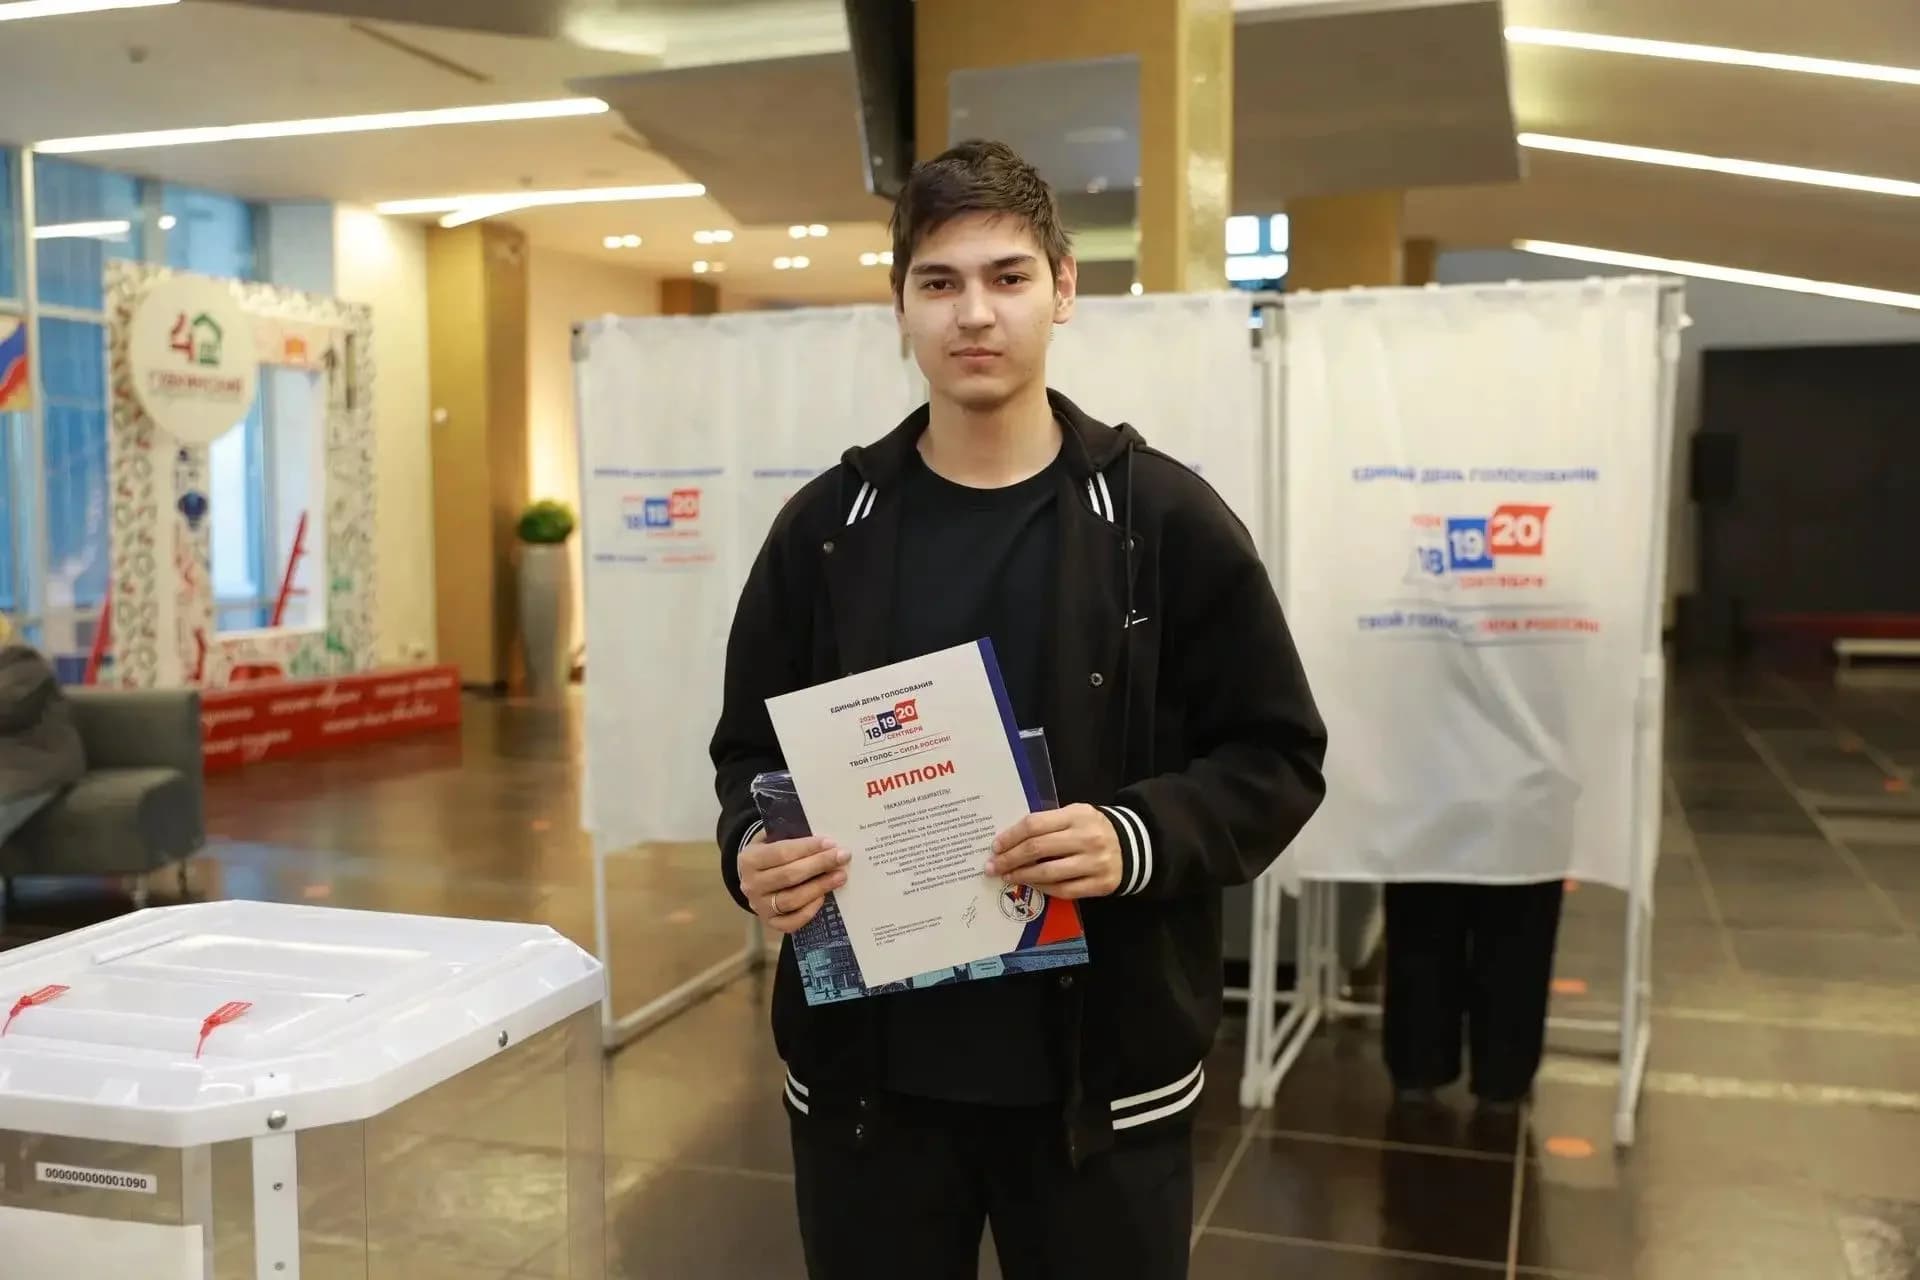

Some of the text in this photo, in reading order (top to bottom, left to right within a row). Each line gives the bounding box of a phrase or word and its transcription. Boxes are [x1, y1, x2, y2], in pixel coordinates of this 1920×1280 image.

[1417, 513, 1542, 576] 18 19 20
[830, 681, 933, 713] ЕДИНЫЙ ДЕНЬ ГОЛОСОВАНИЯ
[865, 705, 915, 740] 18 19 20
[887, 726, 923, 739] СЕНТЯБРЯ
[850, 758, 869, 767] ТВОЙ
[870, 751, 893, 762] ГОЛОС
[900, 744, 919, 753] СИЛА
[865, 761, 955, 798] ДИПЛОМ
